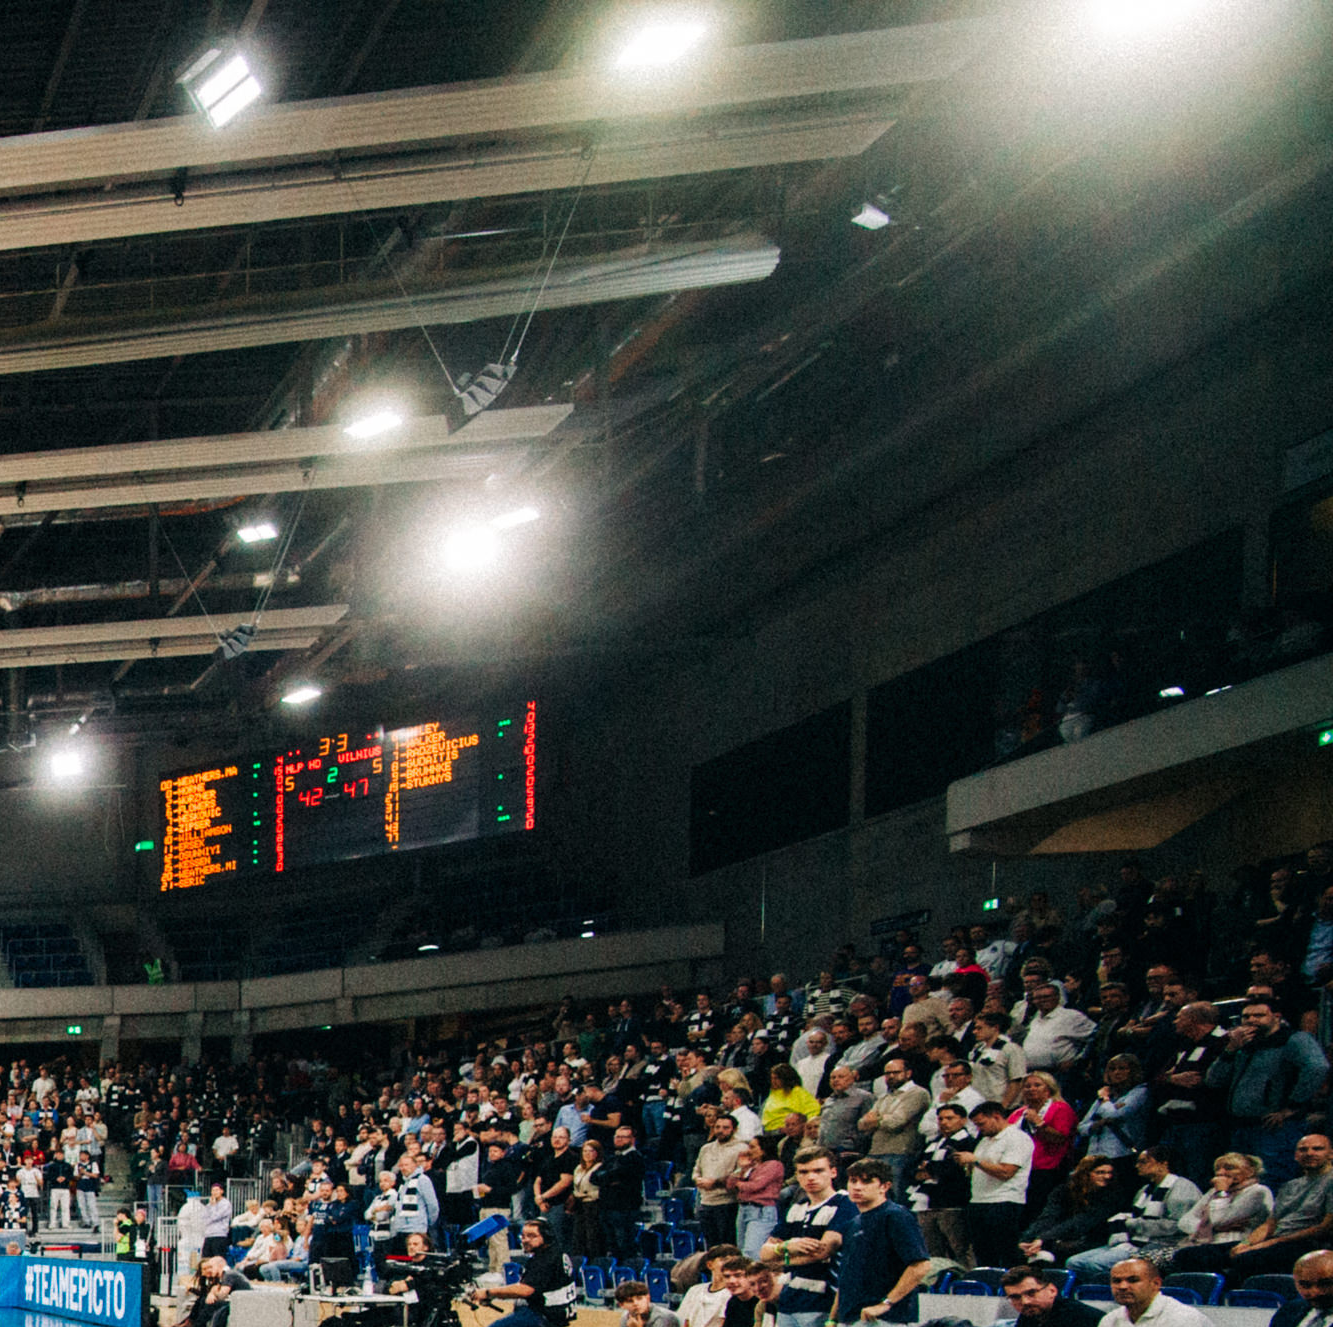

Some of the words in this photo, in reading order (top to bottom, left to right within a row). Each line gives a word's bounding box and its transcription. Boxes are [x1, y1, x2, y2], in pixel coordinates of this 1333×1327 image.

[337, 745, 382, 764] VILNIUS
[326, 766, 339, 783] 2
[298, 787, 323, 807] 42
[343, 777, 370, 798] 47
[25, 1263, 126, 1320] #TEAMEPICTO
